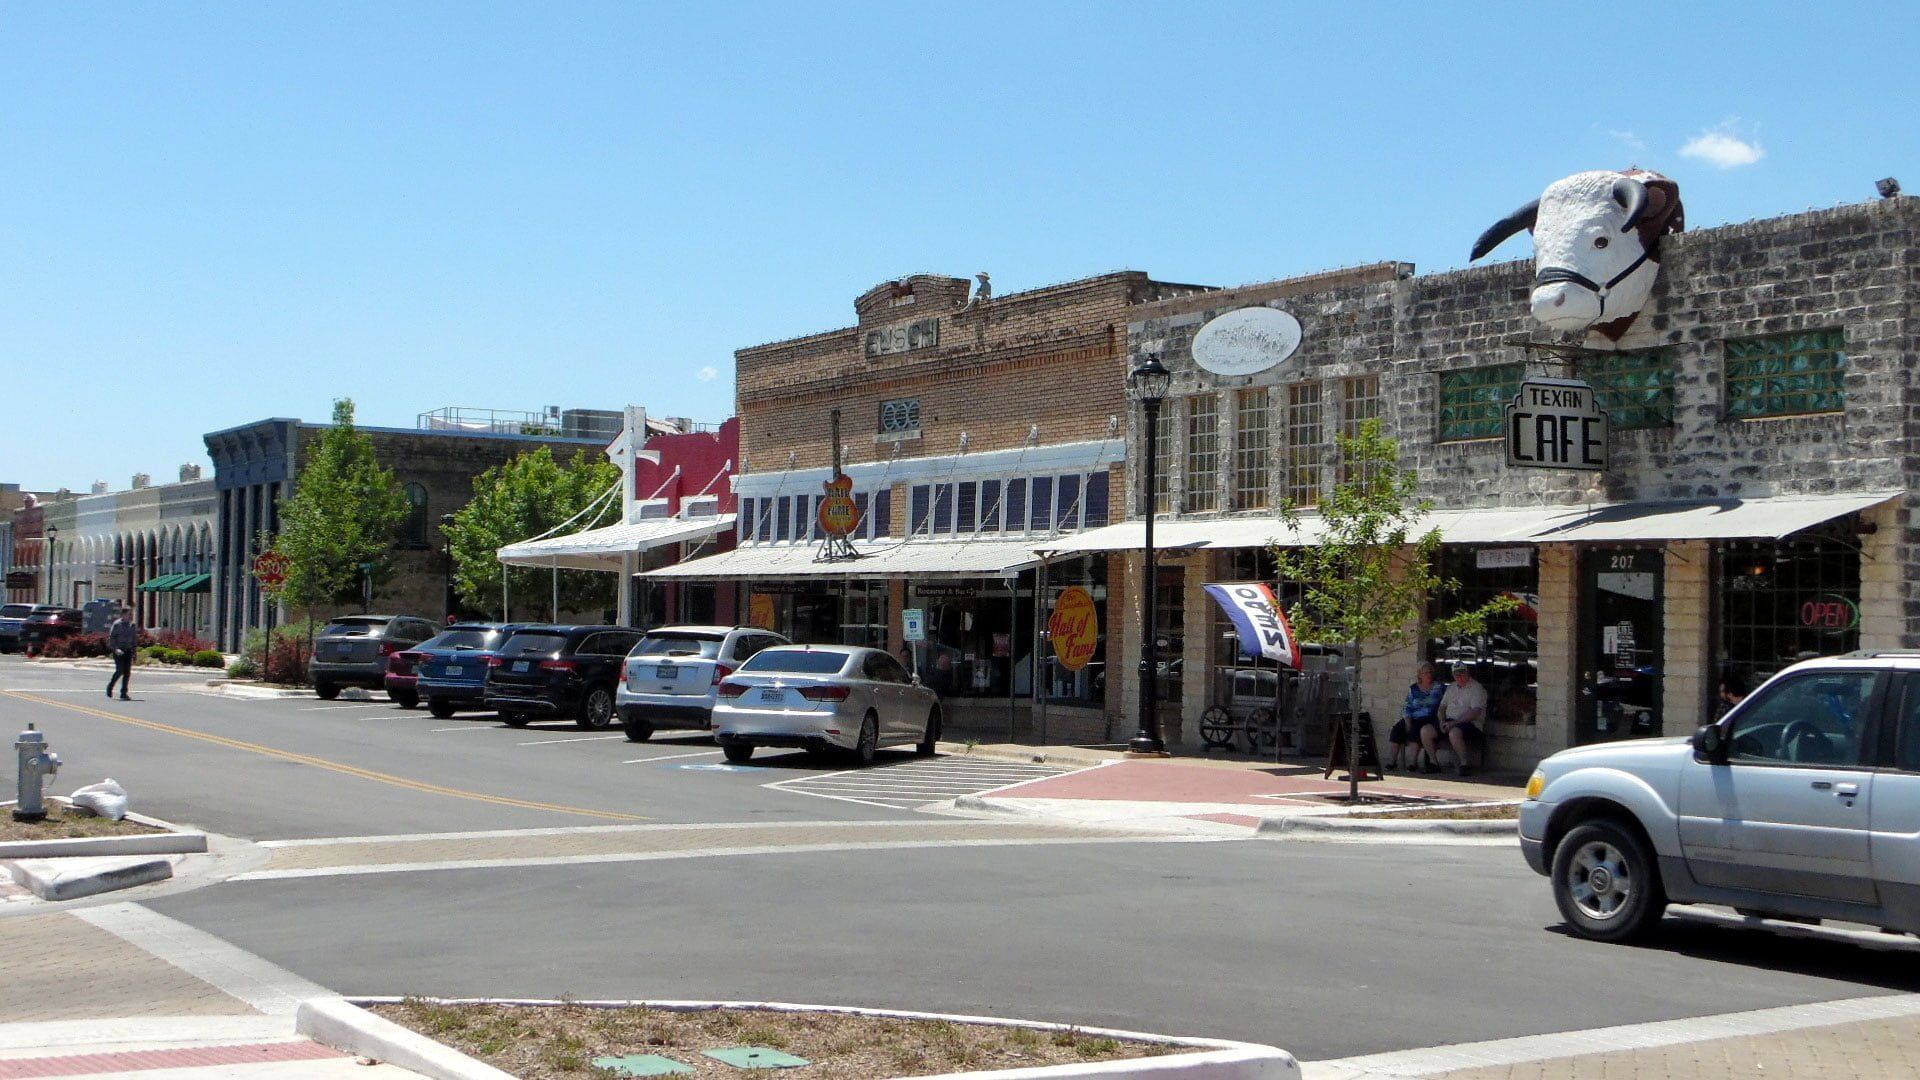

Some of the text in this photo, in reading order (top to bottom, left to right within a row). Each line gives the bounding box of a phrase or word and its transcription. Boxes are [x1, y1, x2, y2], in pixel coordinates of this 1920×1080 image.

[1529, 388, 1582, 409] TEXAN
[1512, 412, 1604, 465] CAFE
[257, 559, 289, 574] STOP
[1611, 555, 1634, 569] 207
[1048, 612, 1090, 637] Hall of
[1801, 601, 1849, 628] OPEN
[1065, 633, 1096, 659] Fame
